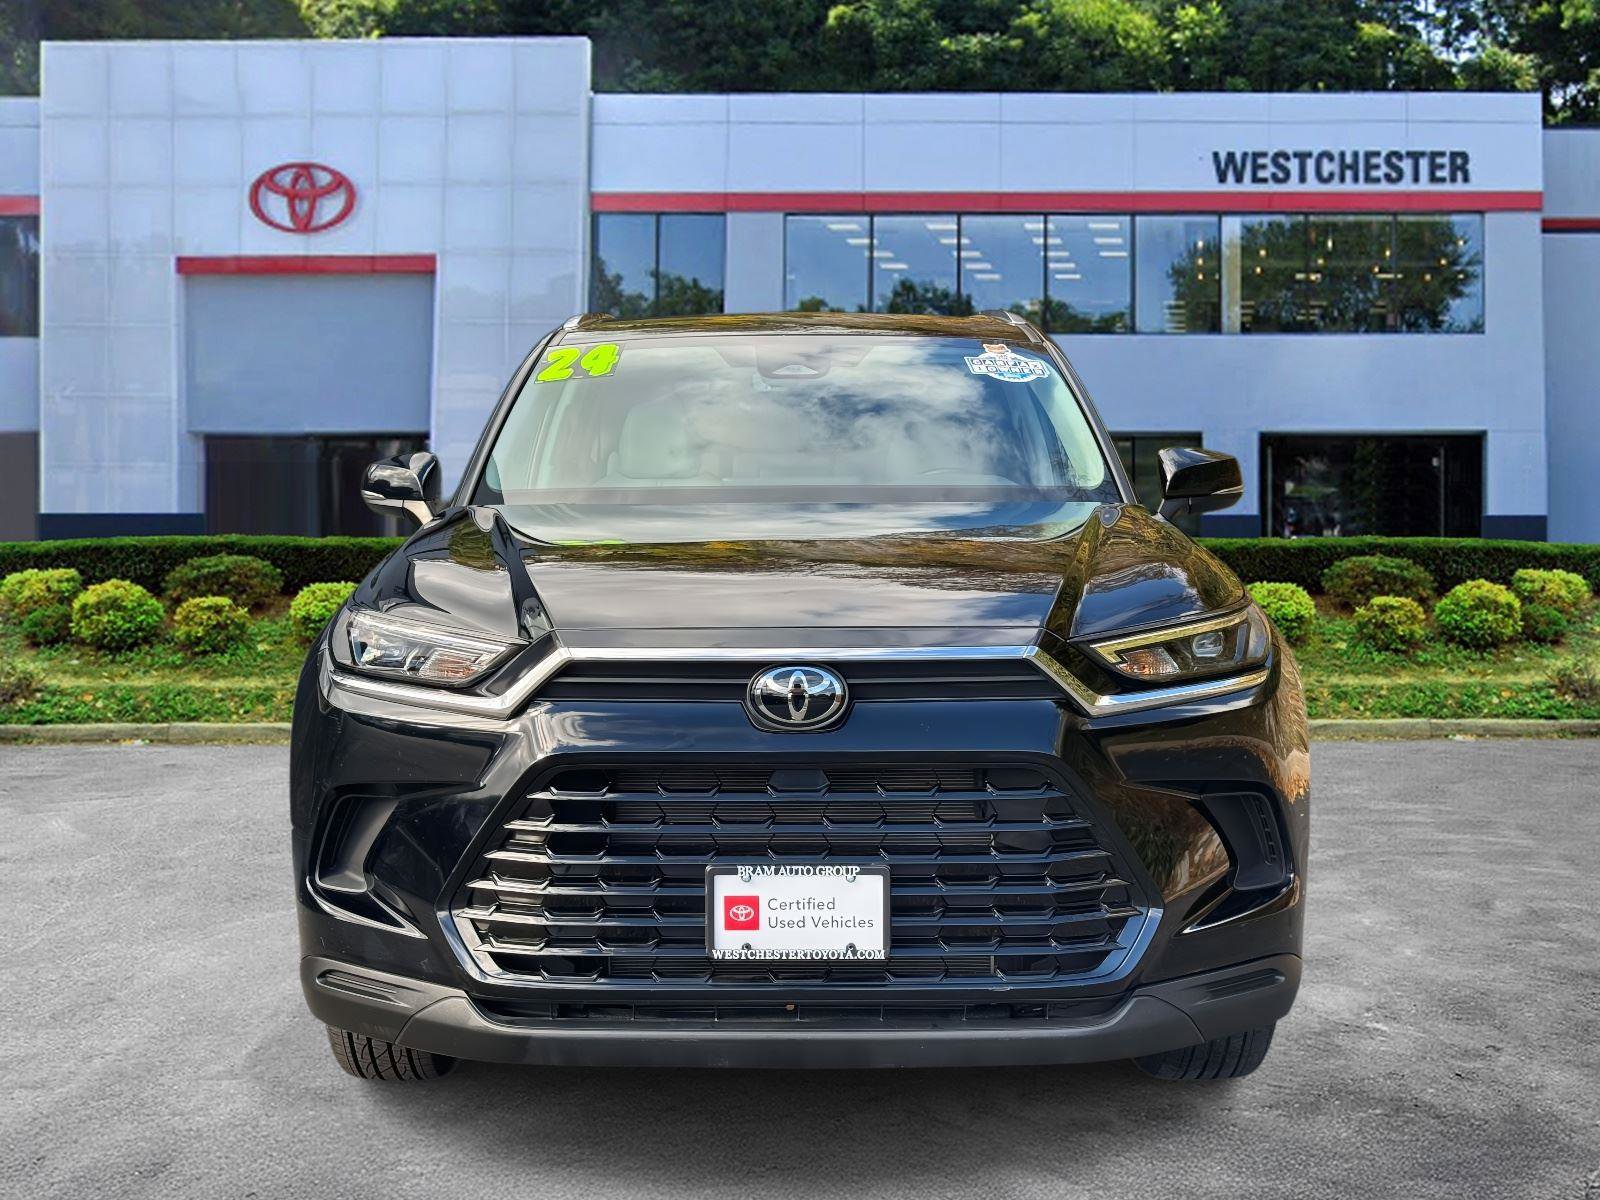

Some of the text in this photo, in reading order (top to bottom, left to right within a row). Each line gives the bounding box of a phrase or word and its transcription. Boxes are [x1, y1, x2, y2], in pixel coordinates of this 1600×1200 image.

[1212, 150, 1471, 184] WESTCHESTER
[537, 344, 620, 381] 24
[737, 865, 860, 876] BRAM AUTO GROUP
[768, 897, 836, 911] Certified
[768, 916, 874, 929] Used Vehicles
[712, 949, 885, 960] WESTCHESTERTOYOTA.COM
